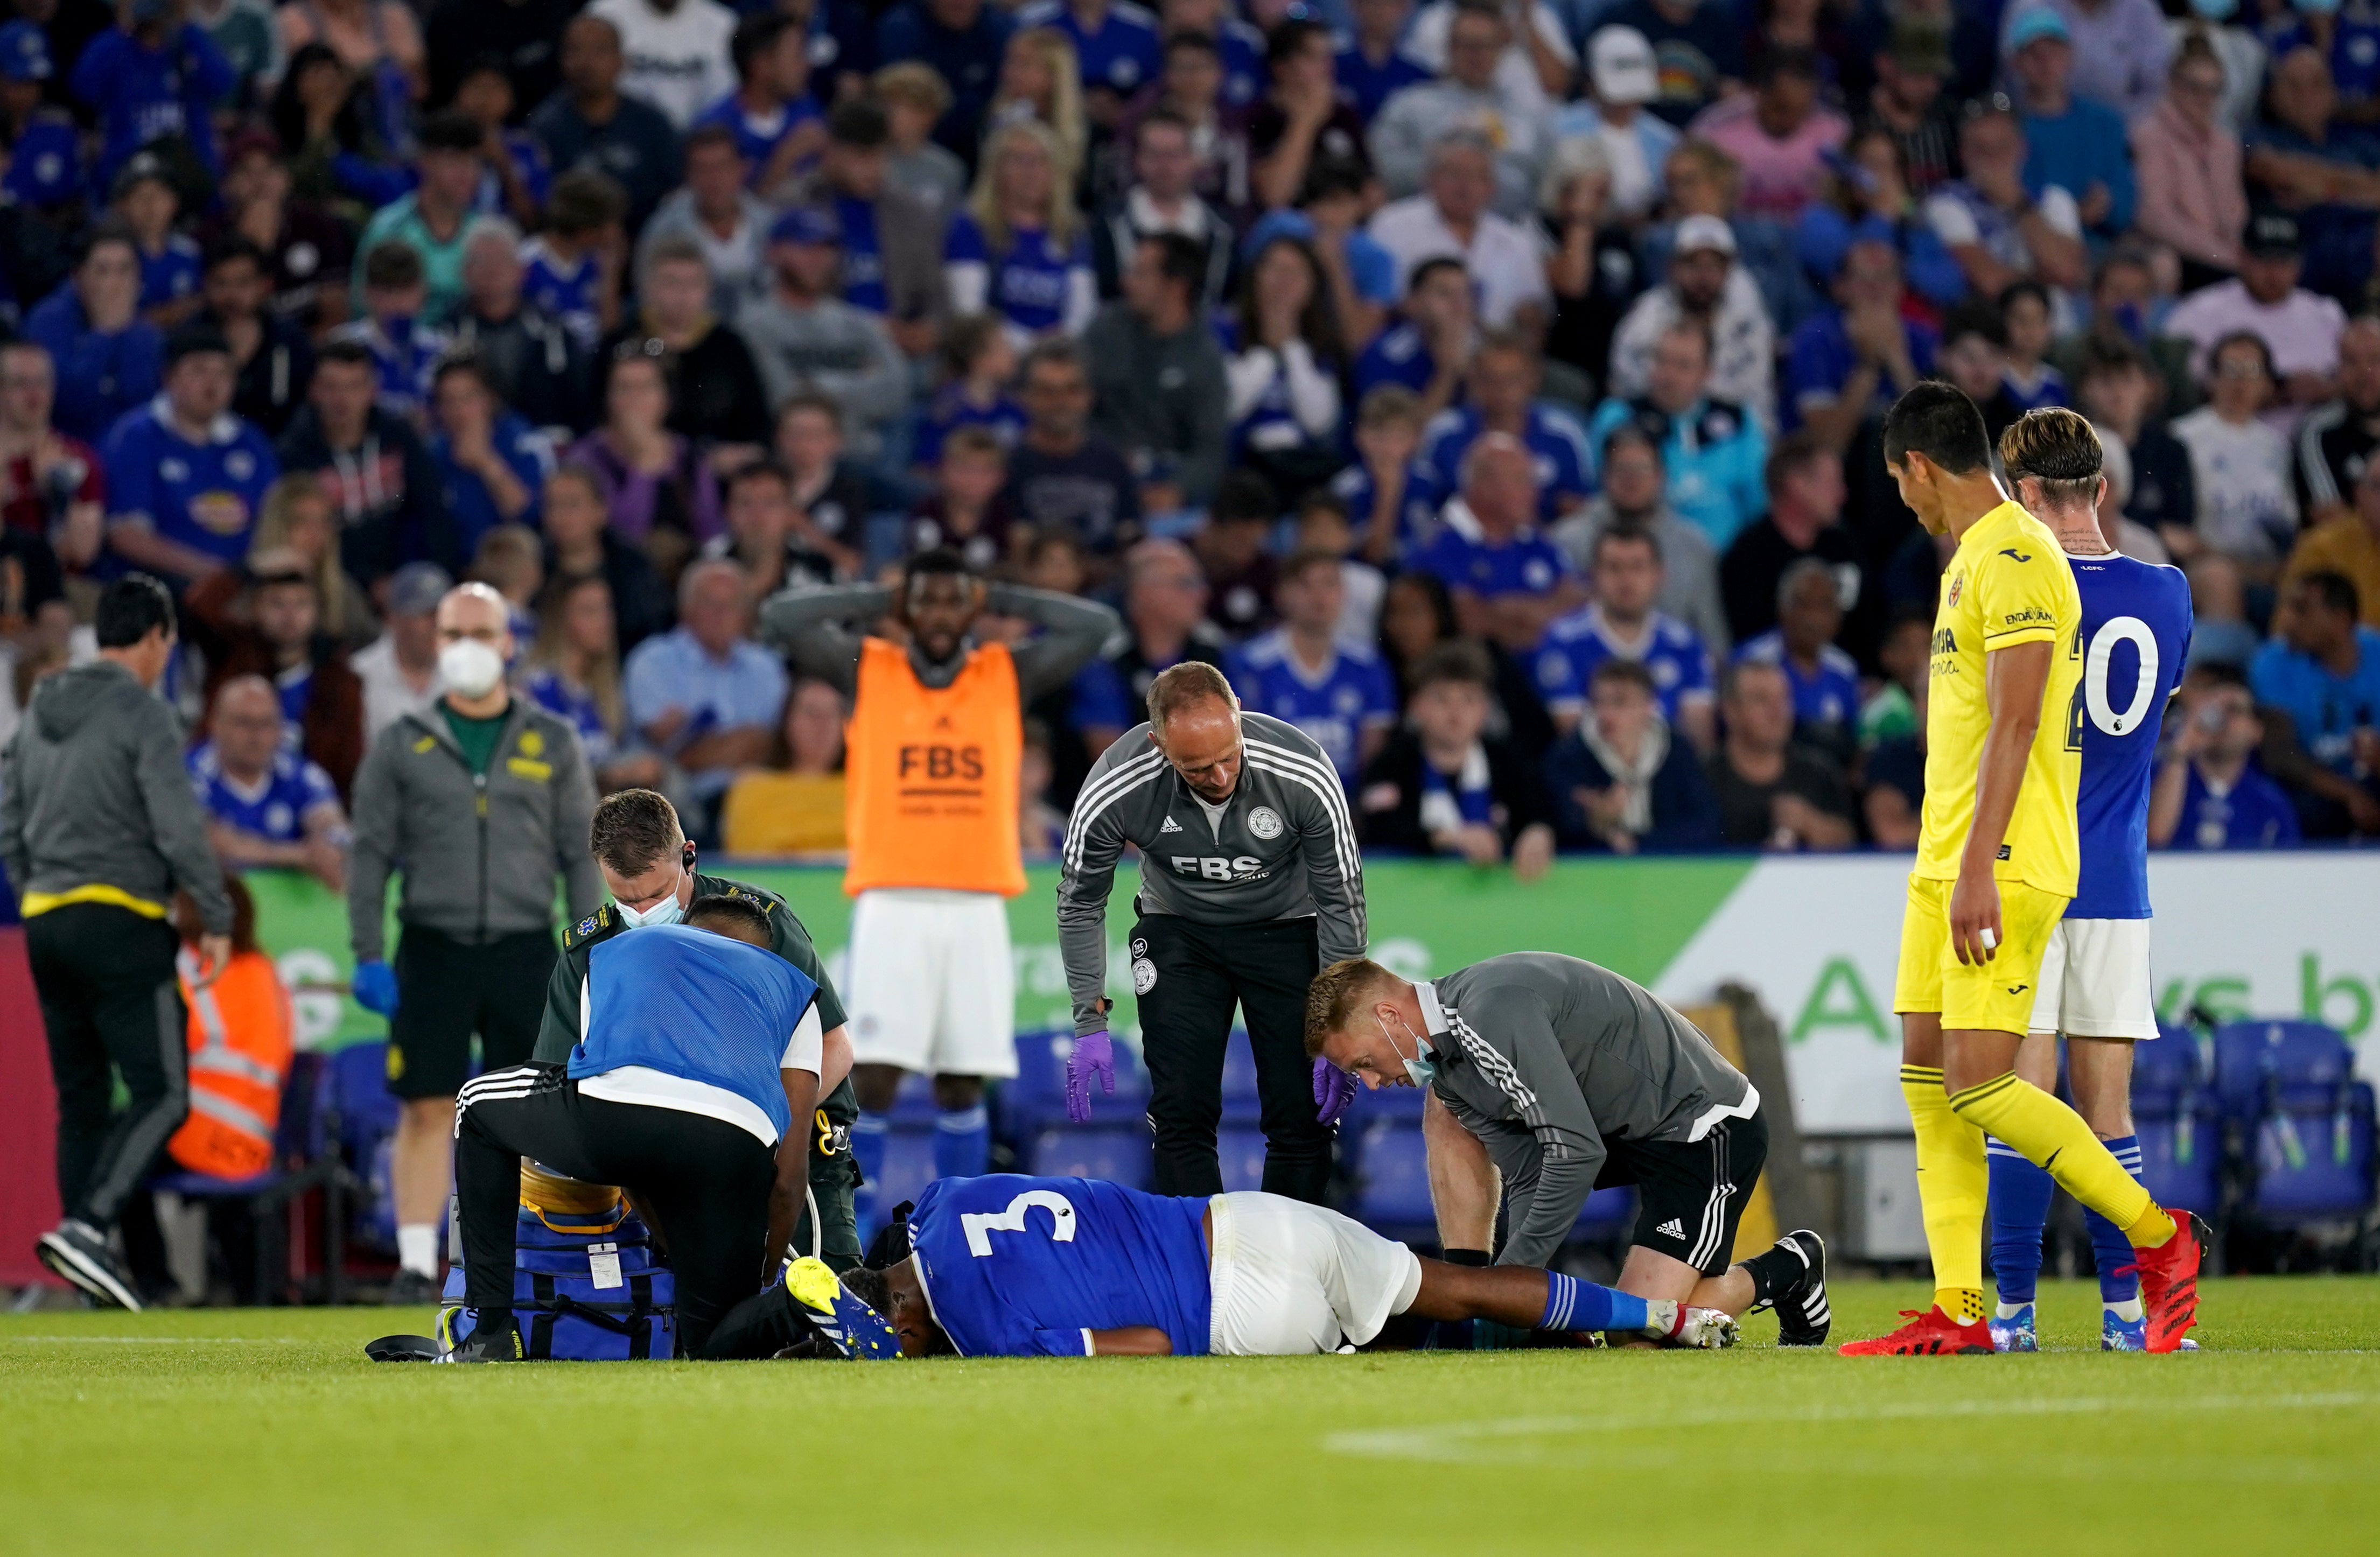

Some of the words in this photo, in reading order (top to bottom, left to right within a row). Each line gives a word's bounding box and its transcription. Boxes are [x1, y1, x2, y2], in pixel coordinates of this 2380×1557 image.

[898, 745, 984, 780] FBS
[1171, 856, 1263, 881] FBS
[960, 1189, 1076, 1258] 3
[1656, 1225, 1686, 1240] adidas
